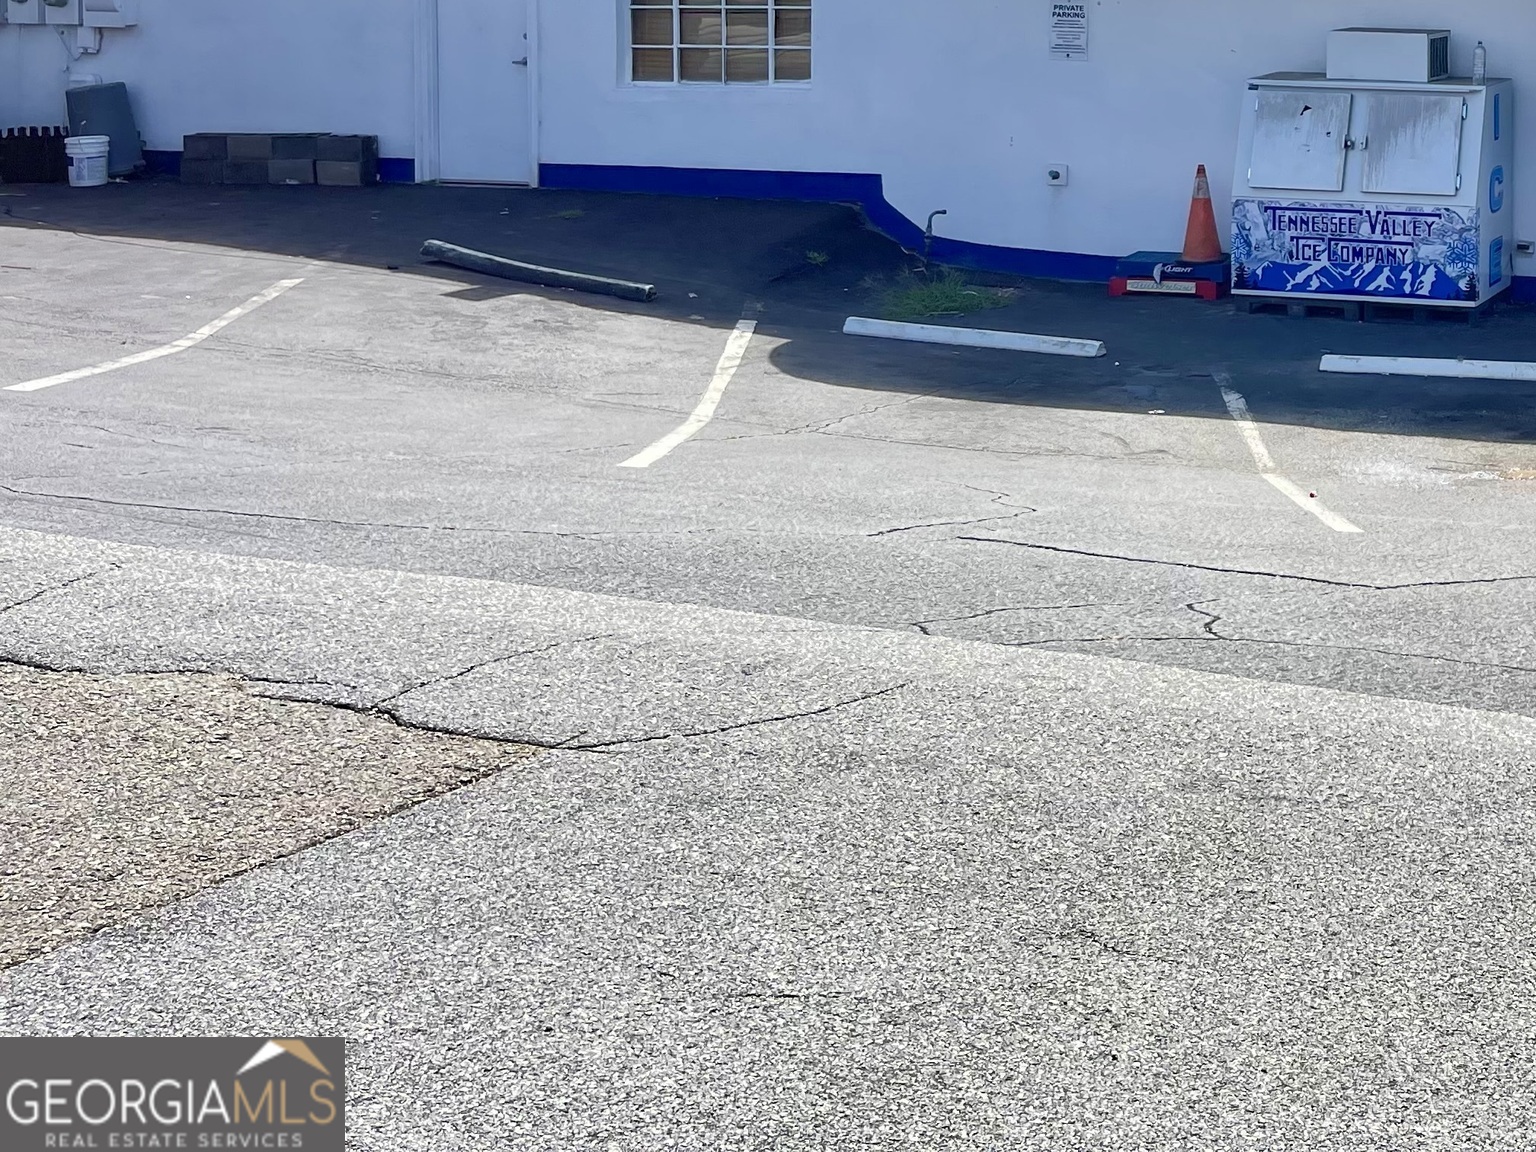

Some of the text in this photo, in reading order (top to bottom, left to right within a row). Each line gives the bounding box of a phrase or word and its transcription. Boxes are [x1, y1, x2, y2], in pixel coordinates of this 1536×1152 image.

[1052, 11, 1086, 19] PARKING
[1053, 4, 1085, 12] PRIVATE
[1264, 205, 1442, 238] TENNESSEE VALLEY
[1290, 235, 1415, 266] ICE COMPANY
